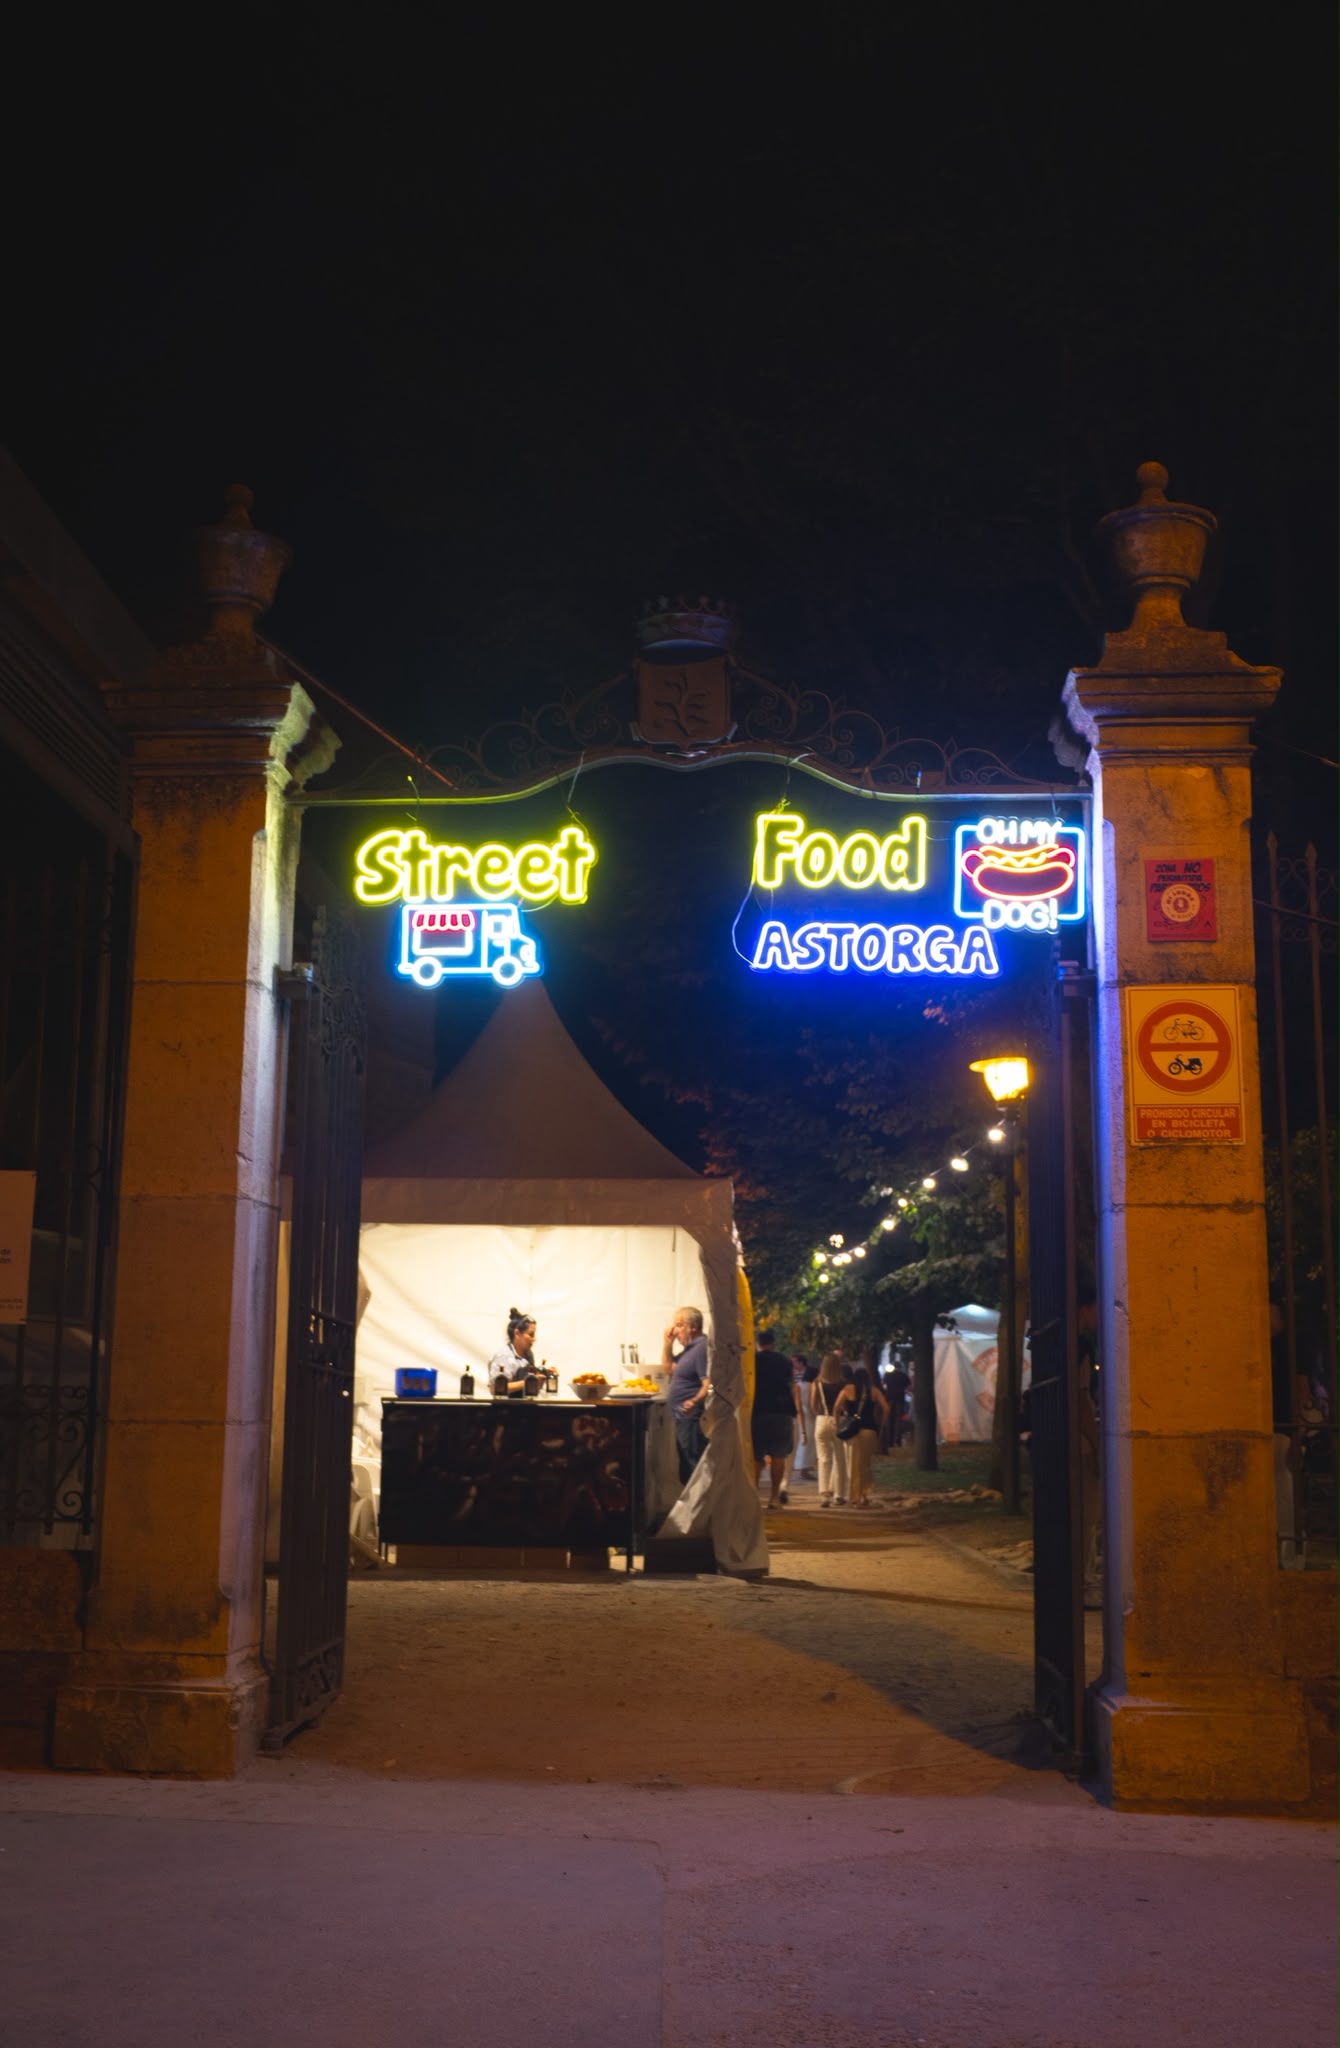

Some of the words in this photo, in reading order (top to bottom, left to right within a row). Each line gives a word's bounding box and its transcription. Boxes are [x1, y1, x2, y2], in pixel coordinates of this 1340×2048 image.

[976, 817, 1018, 844] OH
[1019, 817, 1063, 845] MY
[355, 827, 597, 903] Street
[757, 813, 927, 891] Food
[1184, 861, 1202, 873] NO
[983, 897, 1058, 934] DOG!
[753, 920, 1000, 976] ASTORGA
[1140, 1108, 1190, 1119] PROHIBIDO
[1191, 1108, 1236, 1119] CIRCULAR
[1151, 1119, 1166, 1128] EN
[1171, 1119, 1226, 1128] BICICLETA
[1147, 1129, 1156, 1138] O
[1160, 1129, 1232, 1138] CICLOMOTOR
